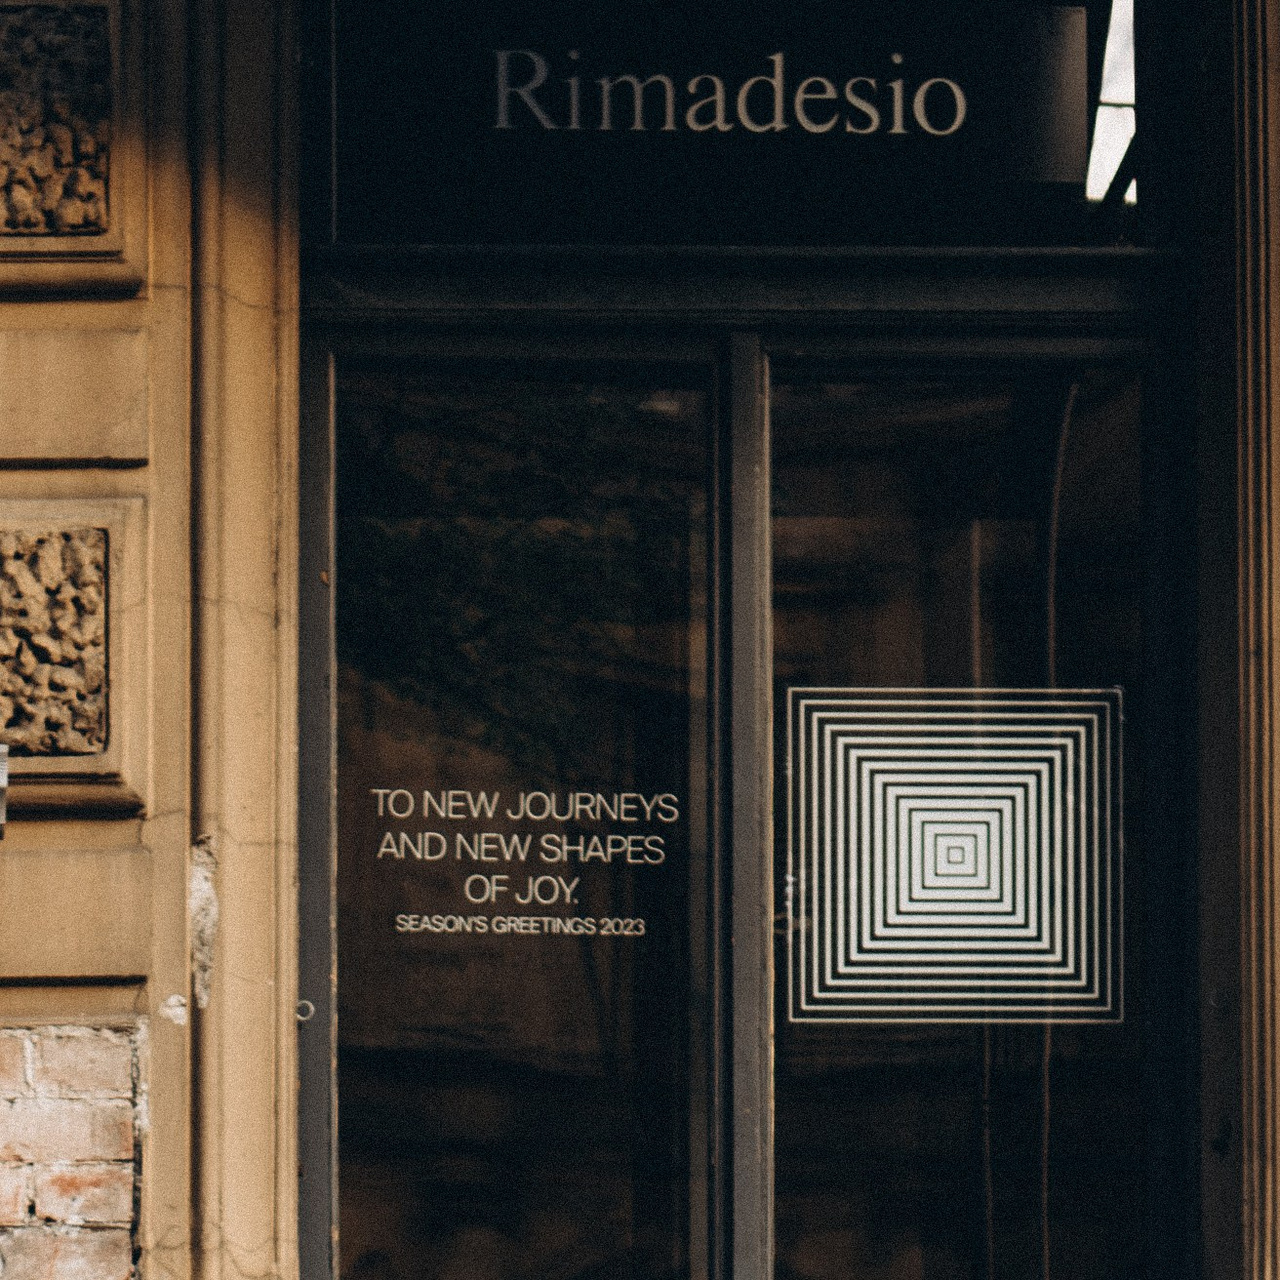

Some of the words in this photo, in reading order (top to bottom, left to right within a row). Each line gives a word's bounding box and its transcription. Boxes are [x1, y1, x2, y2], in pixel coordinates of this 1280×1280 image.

[492, 48, 968, 136] Rimadesio
[370, 788, 415, 818] TO
[423, 790, 500, 820] NEW
[506, 791, 680, 823] JOURNEYS
[377, 831, 447, 861] AND
[455, 832, 532, 862] NEW
[539, 833, 666, 864] SHAPES
[464, 874, 510, 904] OF
[514, 875, 580, 905] JOY.
[395, 914, 489, 933] SEASON'S
[491, 916, 596, 935] GREETINGS
[598, 917, 646, 936] 2023
